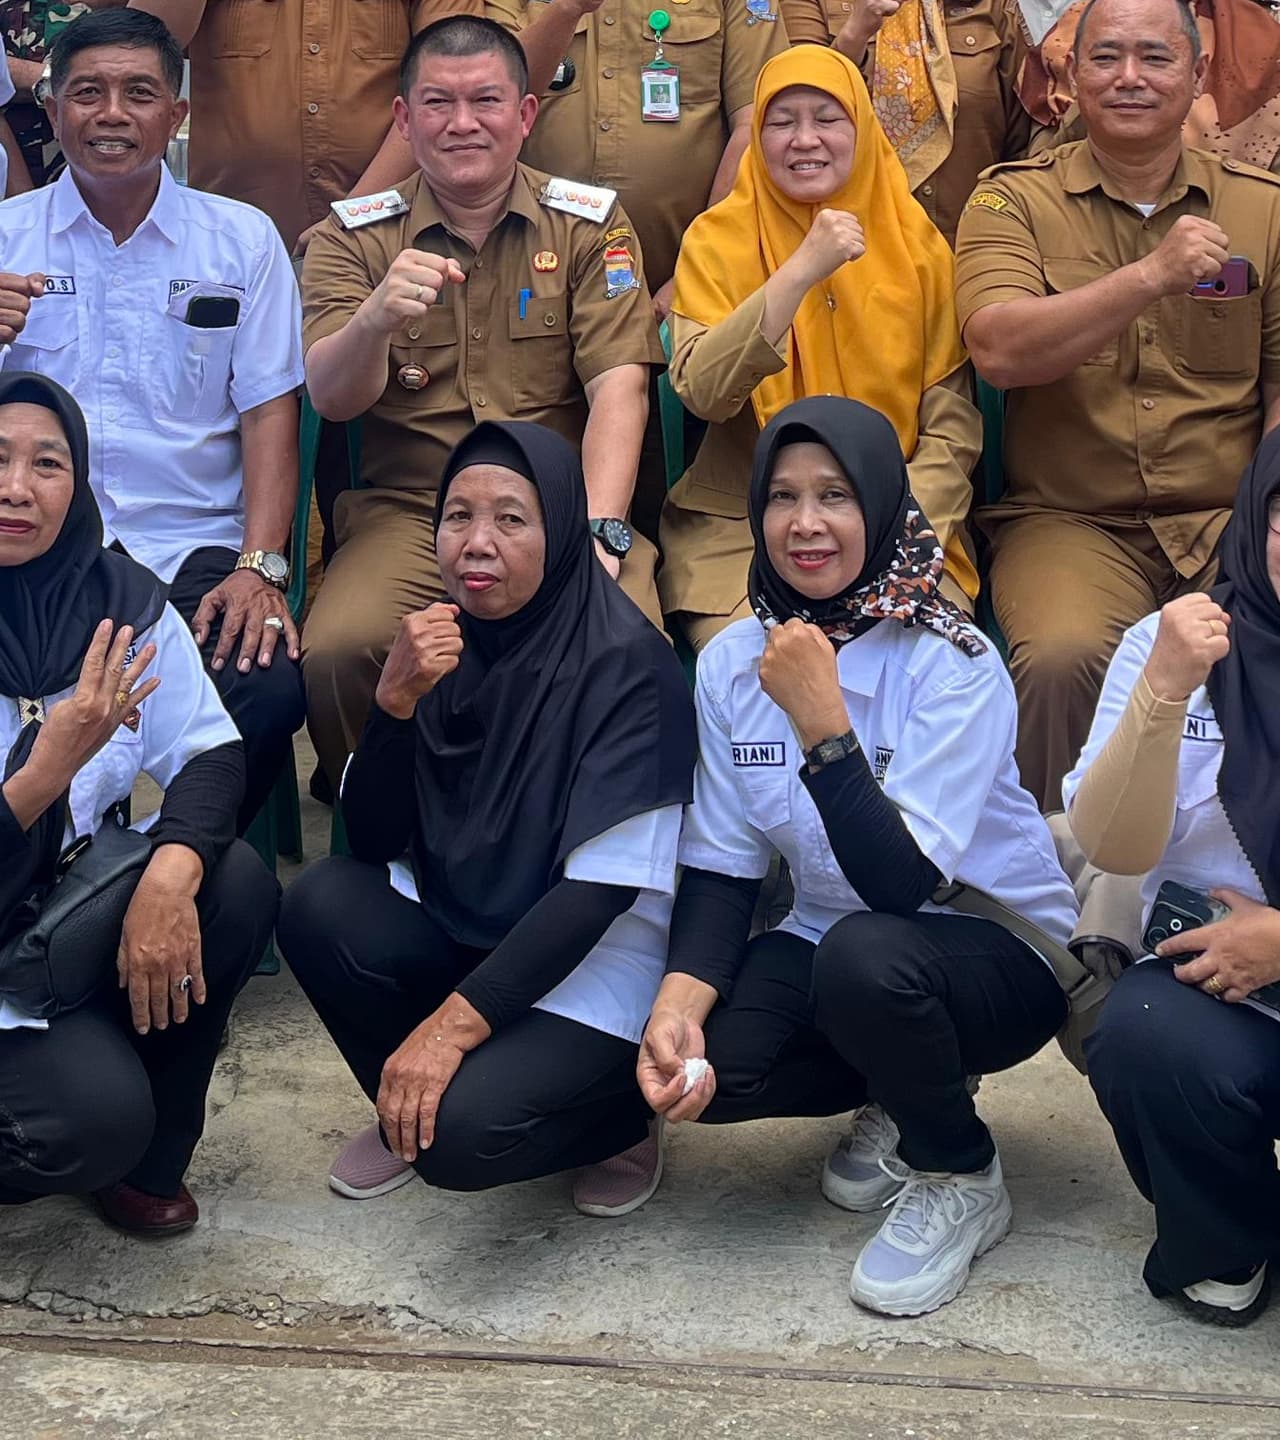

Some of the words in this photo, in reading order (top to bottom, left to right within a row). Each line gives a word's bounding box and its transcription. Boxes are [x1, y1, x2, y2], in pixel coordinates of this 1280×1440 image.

[46, 278, 68, 291] O.S
[1186, 719, 1207, 738] NI
[732, 746, 776, 763] RIANI
